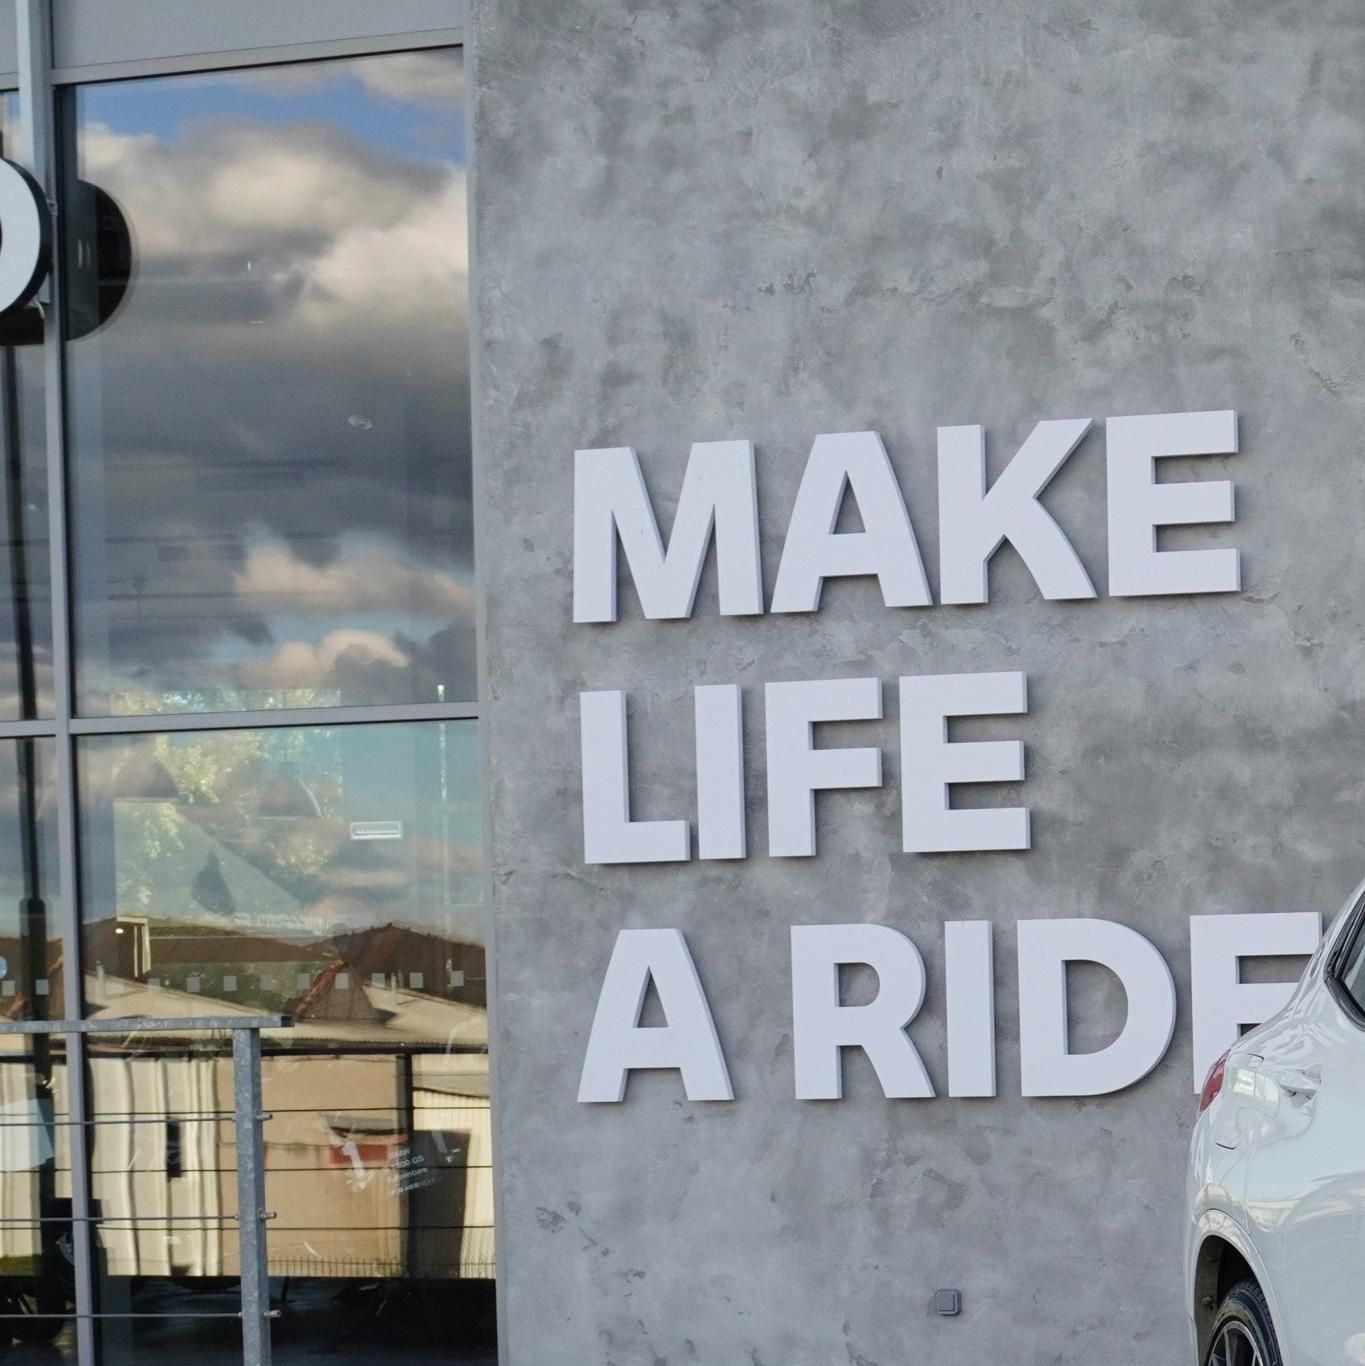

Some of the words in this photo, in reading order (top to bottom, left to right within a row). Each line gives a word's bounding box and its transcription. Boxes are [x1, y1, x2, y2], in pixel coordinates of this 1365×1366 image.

[573, 409, 1241, 623] MAKE
[579, 670, 1031, 865] LIFE
[577, 928, 735, 1103] A
[790, 912, 1322, 1100] RIDE
